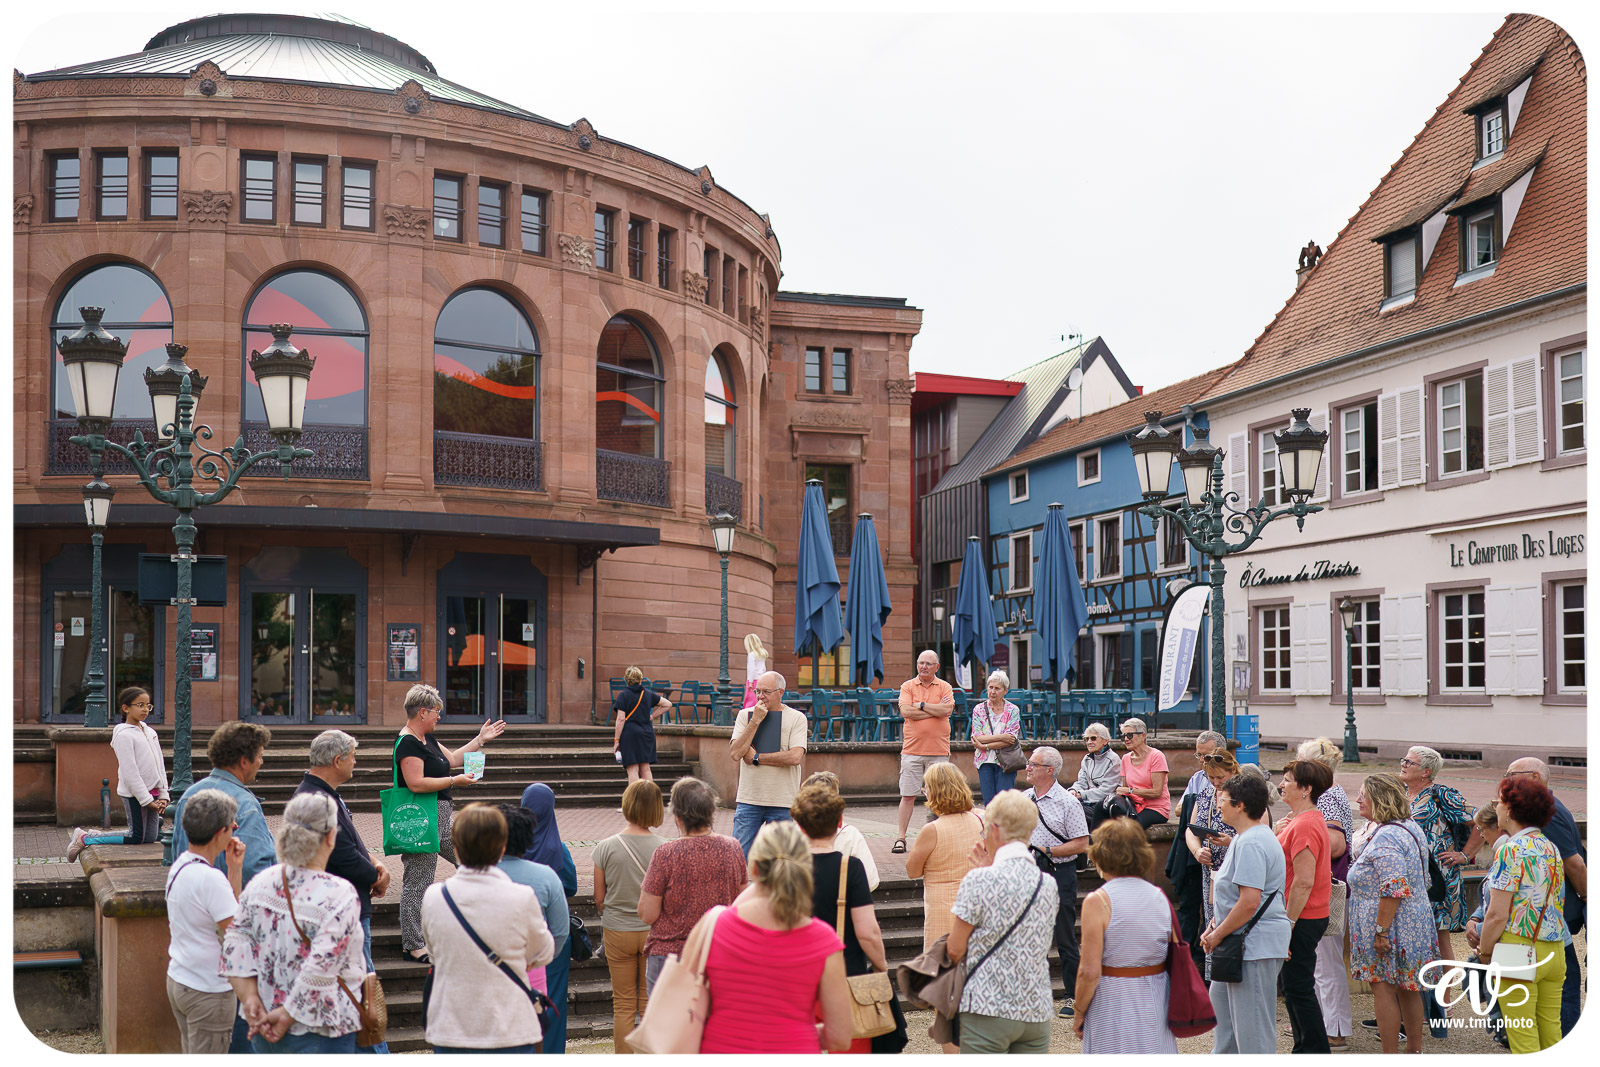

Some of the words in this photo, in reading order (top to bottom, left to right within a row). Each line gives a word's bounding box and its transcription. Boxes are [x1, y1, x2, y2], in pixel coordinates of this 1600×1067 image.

[1450, 543, 1464, 567] LE
[1522, 533, 1545, 559] DES
[1292, 564, 1310, 582] du
[1085, 602, 1109, 614] nôme
[1162, 625, 1179, 704] RESTAURANT
